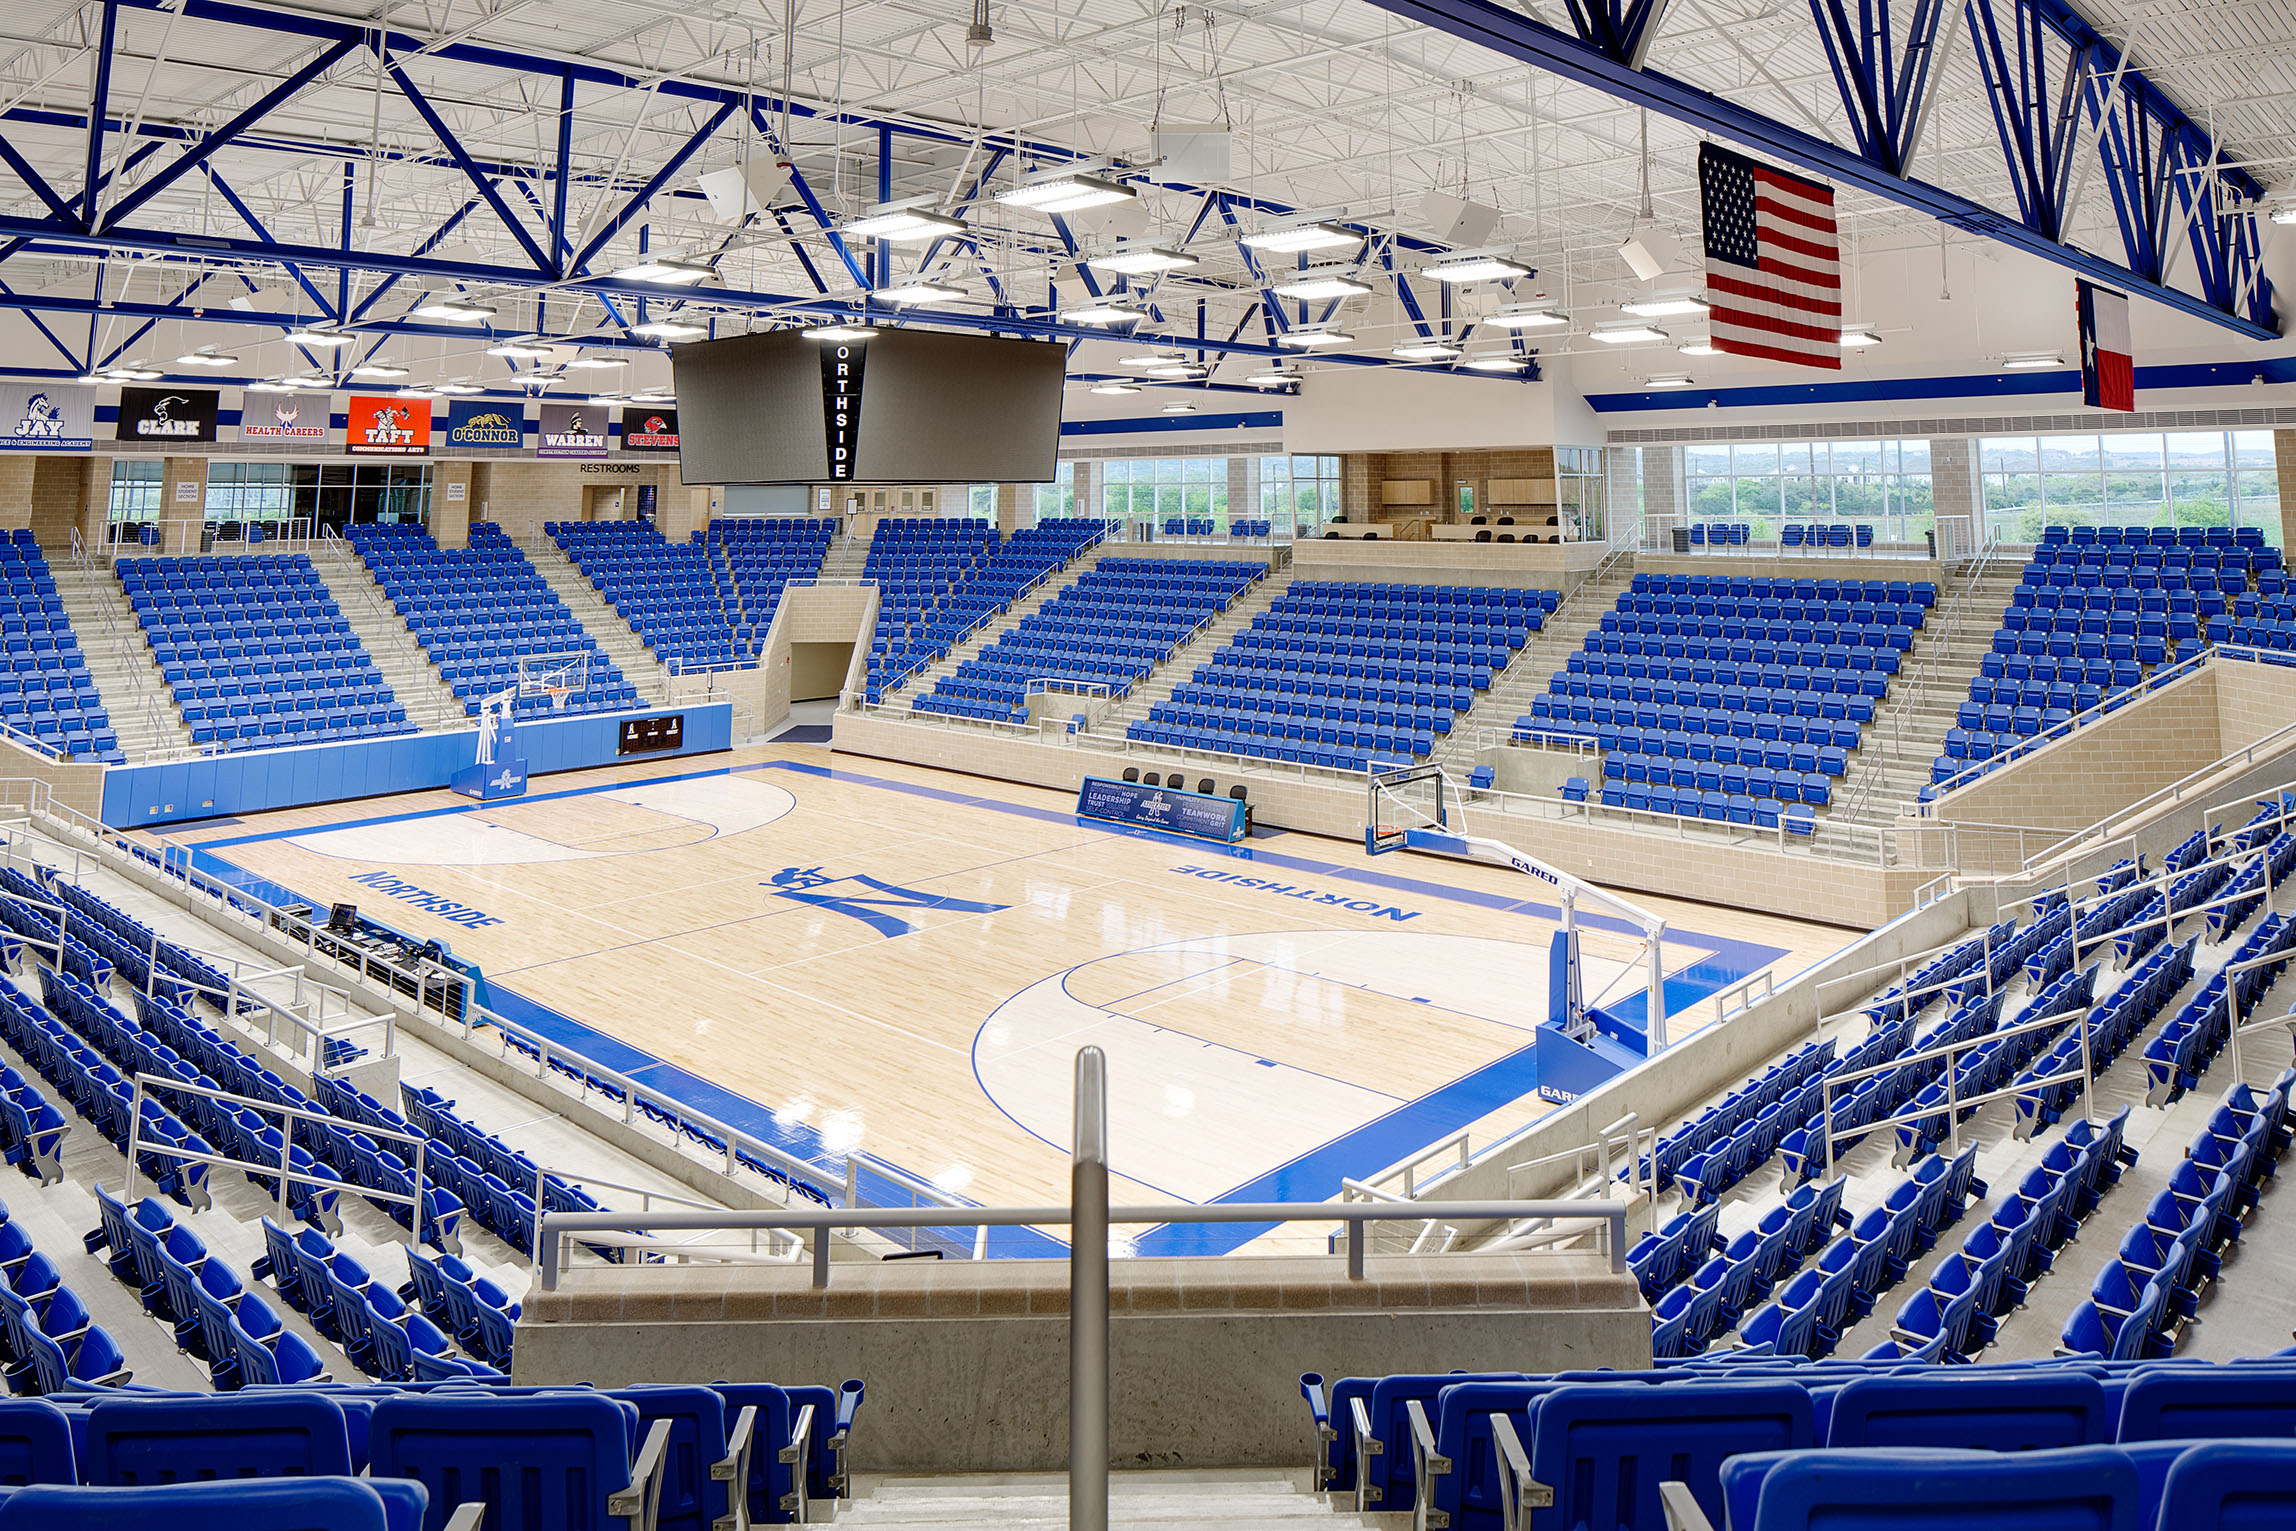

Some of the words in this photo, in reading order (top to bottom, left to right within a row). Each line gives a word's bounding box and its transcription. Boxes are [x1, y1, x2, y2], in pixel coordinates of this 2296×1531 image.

[835, 346, 849, 478] ORTHSIDE
[15, 419, 64, 436] JAY
[137, 419, 200, 436] CLARK
[245, 425, 282, 436] HEALTH
[284, 426, 324, 438] CAREERS
[365, 429, 415, 443] TAFT
[452, 427, 518, 443] O'CONNOR
[545, 433, 604, 447] WARREN
[627, 433, 679, 446] STEVENS
[17, 439, 61, 447] ENGINEERING
[580, 463, 640, 473] RESTROOMS
[1088, 792, 1131, 805] LEADERSHIP
[1121, 791, 1138, 799] HOPE
[1087, 799, 1104, 807] TRUST
[1181, 808, 1227, 822] TEAMWORK
[1209, 820, 1225, 828] GRIT
[1512, 857, 1558, 885] GARED
[1168, 864, 1422, 921] NORTHSIDE
[347, 871, 505, 930] NORTHSIDE
[1541, 1085, 1580, 1102] GAR
